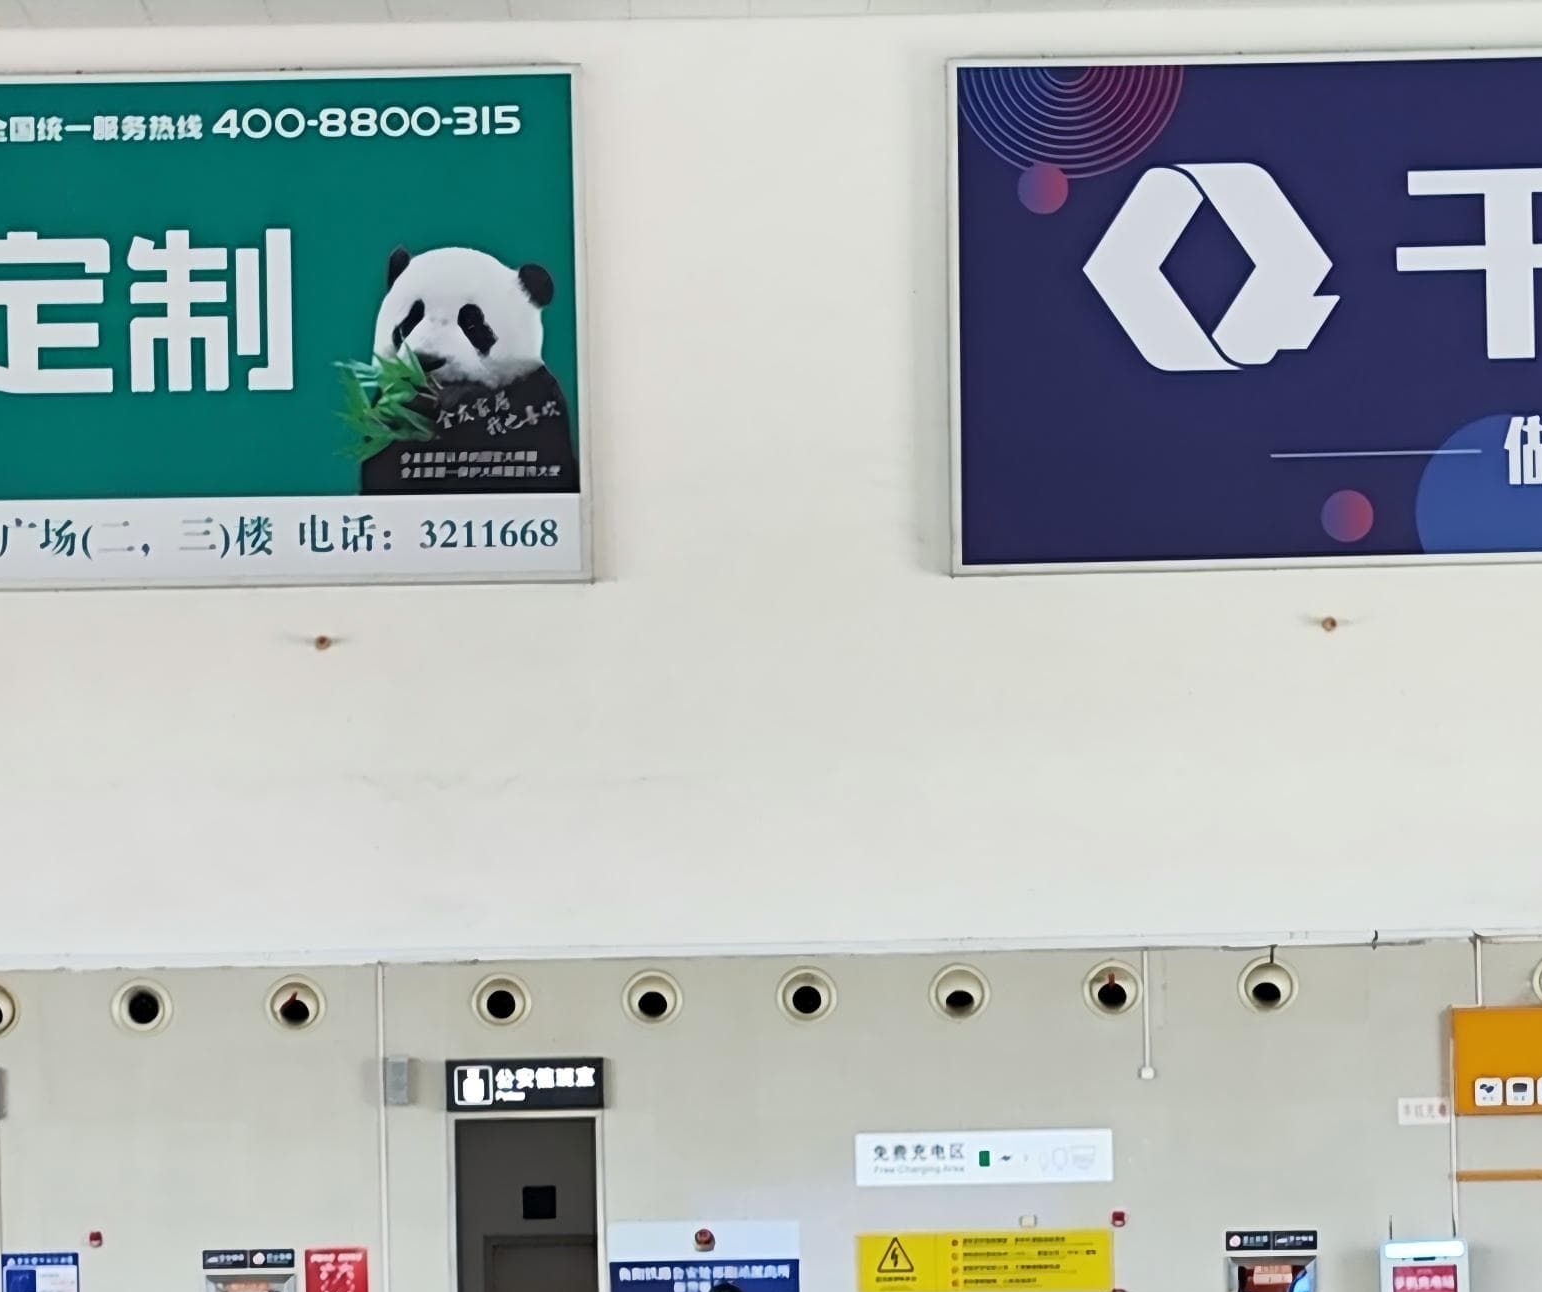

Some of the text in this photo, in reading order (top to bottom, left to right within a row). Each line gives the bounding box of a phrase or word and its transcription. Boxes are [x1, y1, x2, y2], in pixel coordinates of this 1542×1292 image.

[212, 106, 522, 140] 400-8800-315
[872, 1143, 965, 1162] 免费充电区
